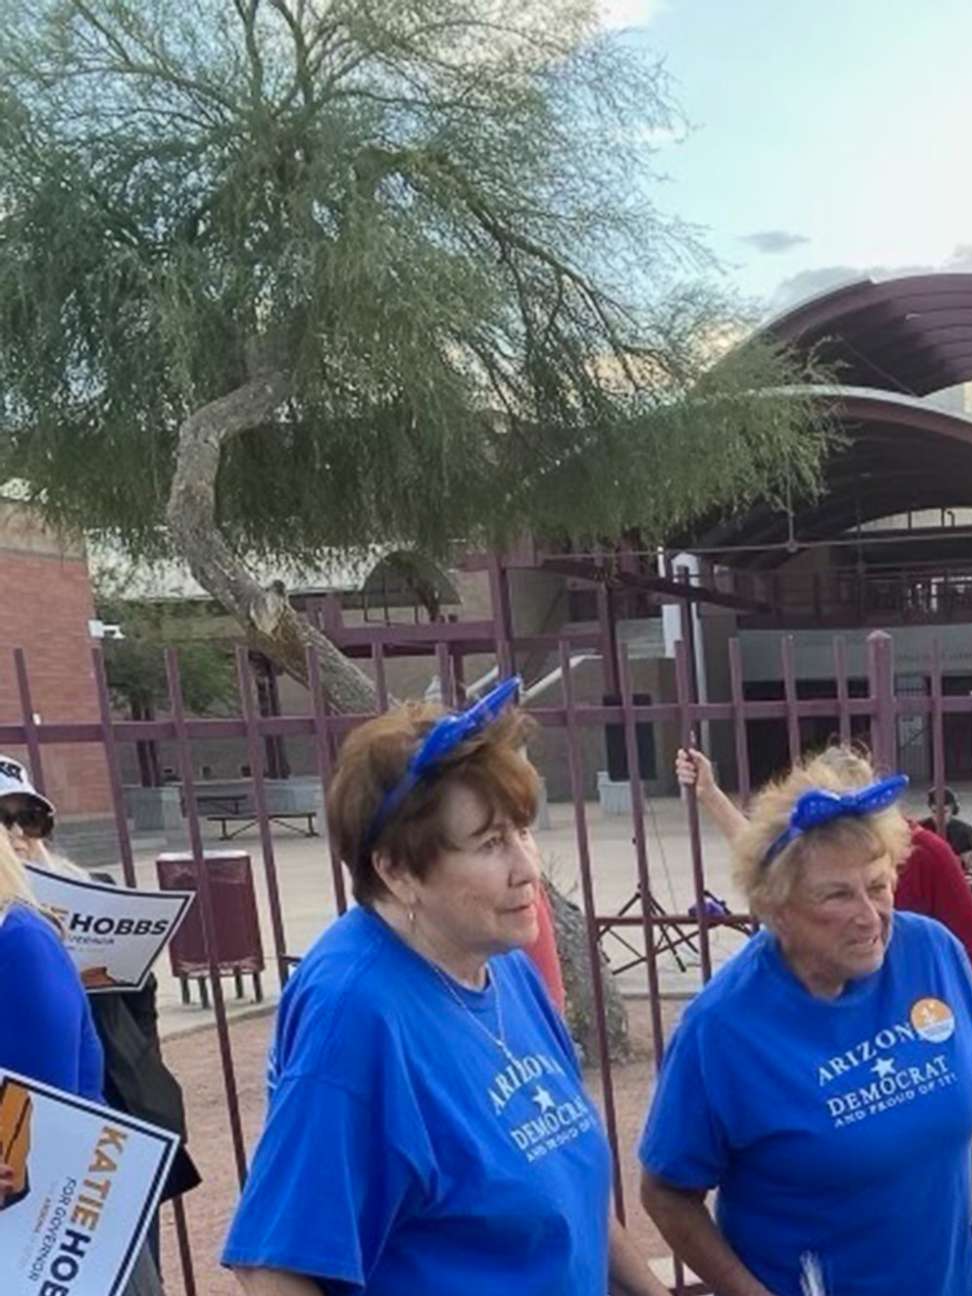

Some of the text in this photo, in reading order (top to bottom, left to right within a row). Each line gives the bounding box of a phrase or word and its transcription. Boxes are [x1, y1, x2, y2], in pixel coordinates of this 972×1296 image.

[69, 912, 169, 935] HOBBS
[817, 1021, 924, 1087] ARIZON
[827, 1055, 949, 1116] DEMOCRAT
[834, 1109, 866, 1128] AND
[869, 1089, 915, 1115] PROUD
[918, 1081, 936, 1095] OF
[57, 1177, 78, 1207] FOR
[69, 1125, 128, 1232] KATIE
[27, 1204, 68, 1283] GOVERNOR
